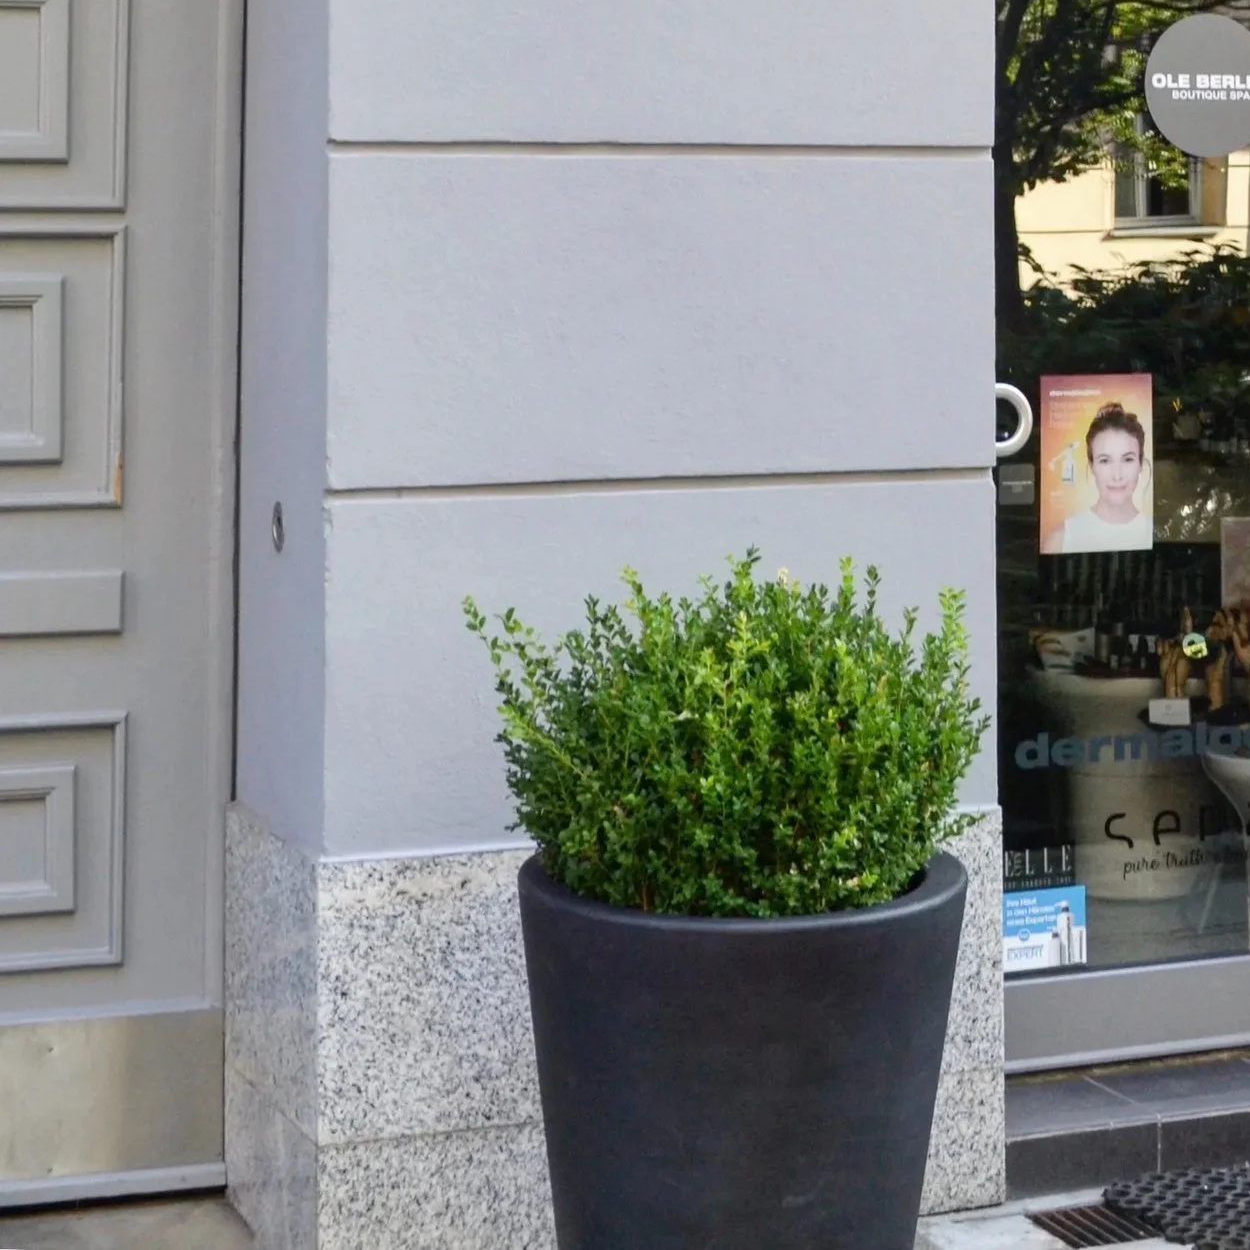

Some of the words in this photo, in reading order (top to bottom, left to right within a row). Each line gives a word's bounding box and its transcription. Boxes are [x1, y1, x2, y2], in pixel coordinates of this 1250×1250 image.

[1151, 72, 1191, 89] OLE
[1171, 89, 1228, 100] BOUTIQUE
[1230, 90, 1250, 101] SPA
[1004, 844, 1073, 878] ELLE
[1123, 855, 1161, 881] pure
